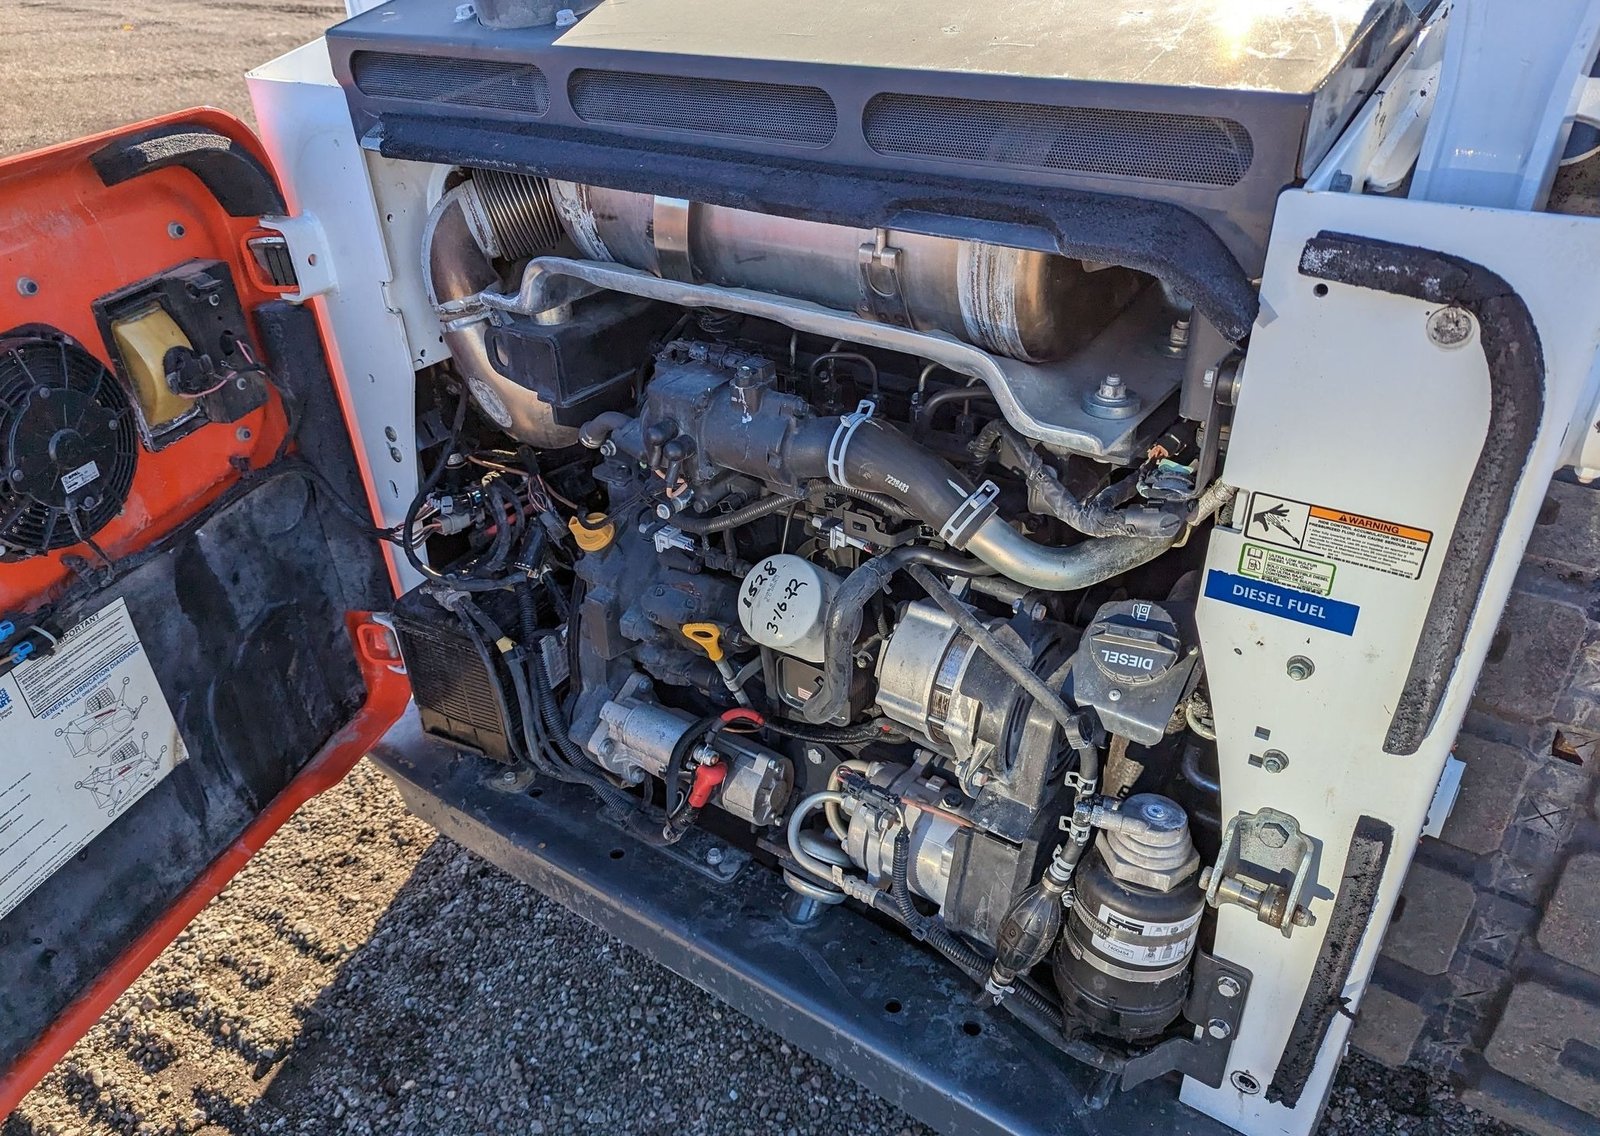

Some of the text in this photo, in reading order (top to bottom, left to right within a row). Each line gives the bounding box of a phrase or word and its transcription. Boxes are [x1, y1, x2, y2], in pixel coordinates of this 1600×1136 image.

[1309, 522, 1341, 532] PRESSURIZED
[1349, 517, 1400, 534] WARNING
[1354, 528, 1390, 539] ACCUMULATOR
[1391, 537, 1417, 546] INSTALLED
[743, 561, 777, 608] 1528
[1233, 584, 1326, 619] DIESEL FUEL
[1101, 650, 1154, 670] DIESEL
[41, 697, 74, 720] GENERAL
[74, 671, 112, 701] LUBRICATION
[109, 646, 140, 673] DIAGRAMS
